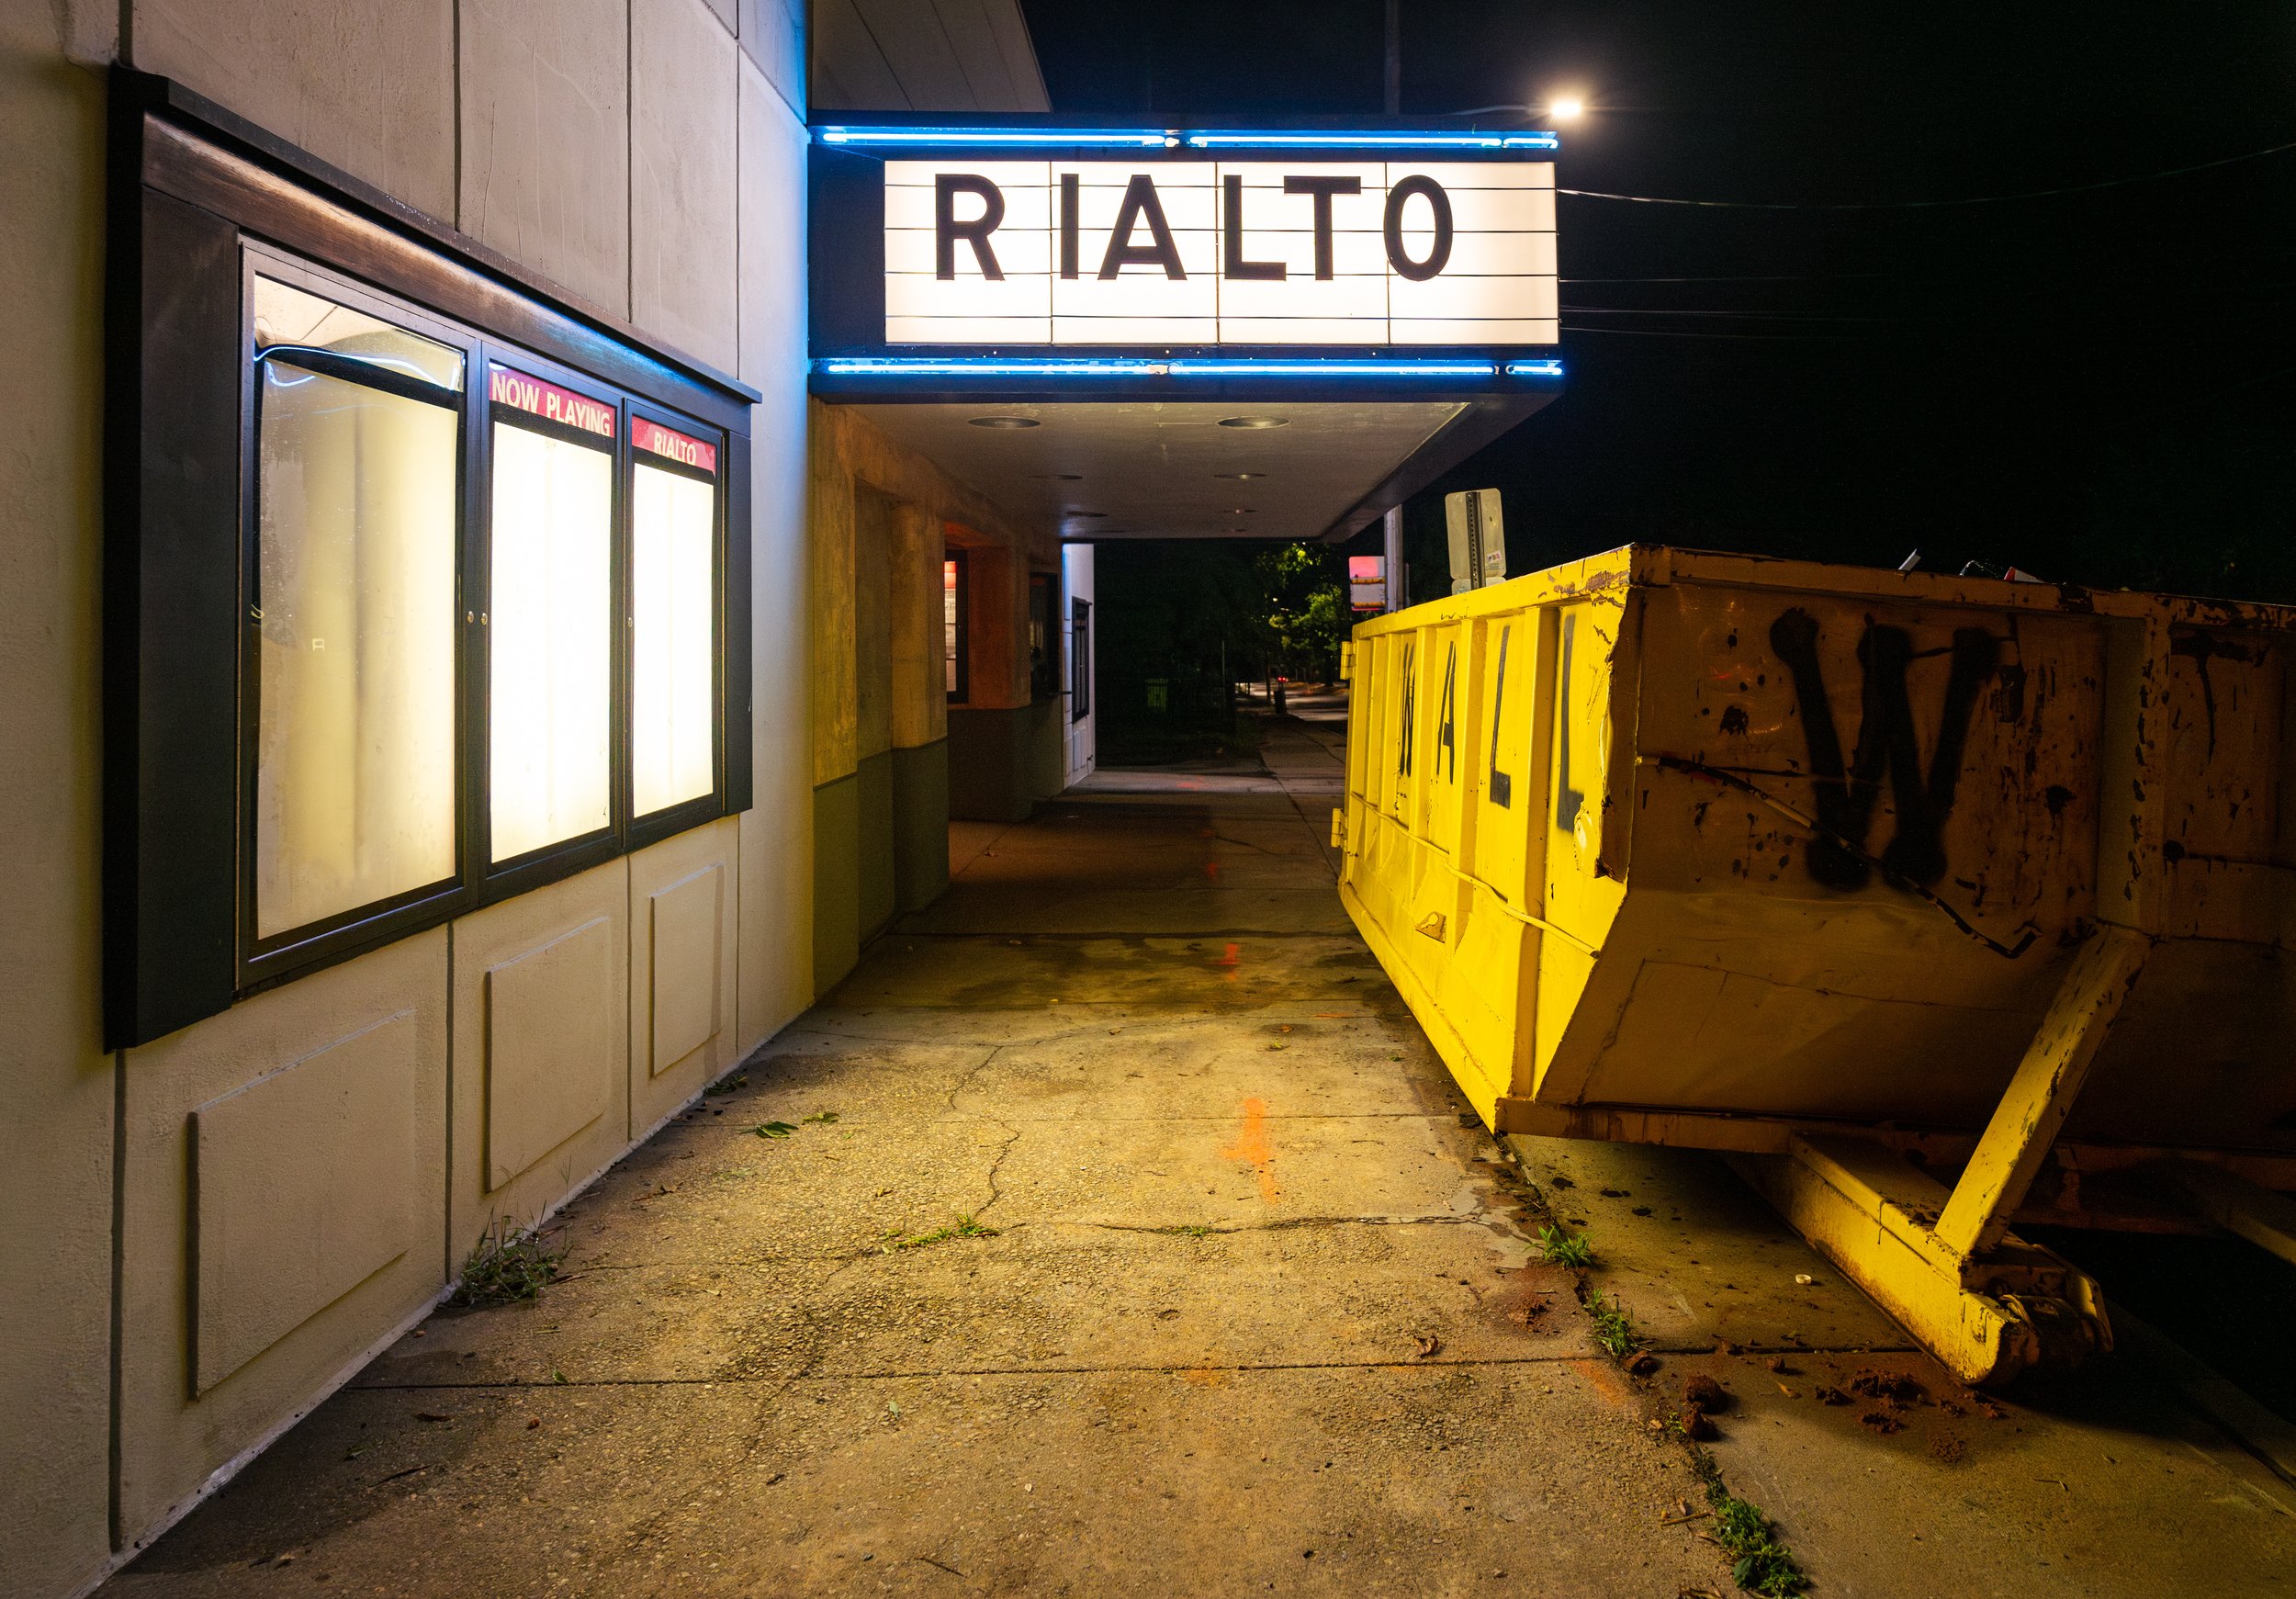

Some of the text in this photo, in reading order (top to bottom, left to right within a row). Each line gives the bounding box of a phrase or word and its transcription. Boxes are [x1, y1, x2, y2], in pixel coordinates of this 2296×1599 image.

[935, 174, 1454, 281] RIALTO
[492, 372, 611, 437] NOW PLAYING
[653, 432, 696, 466] RIALTO
[1770, 606, 2000, 890] W
